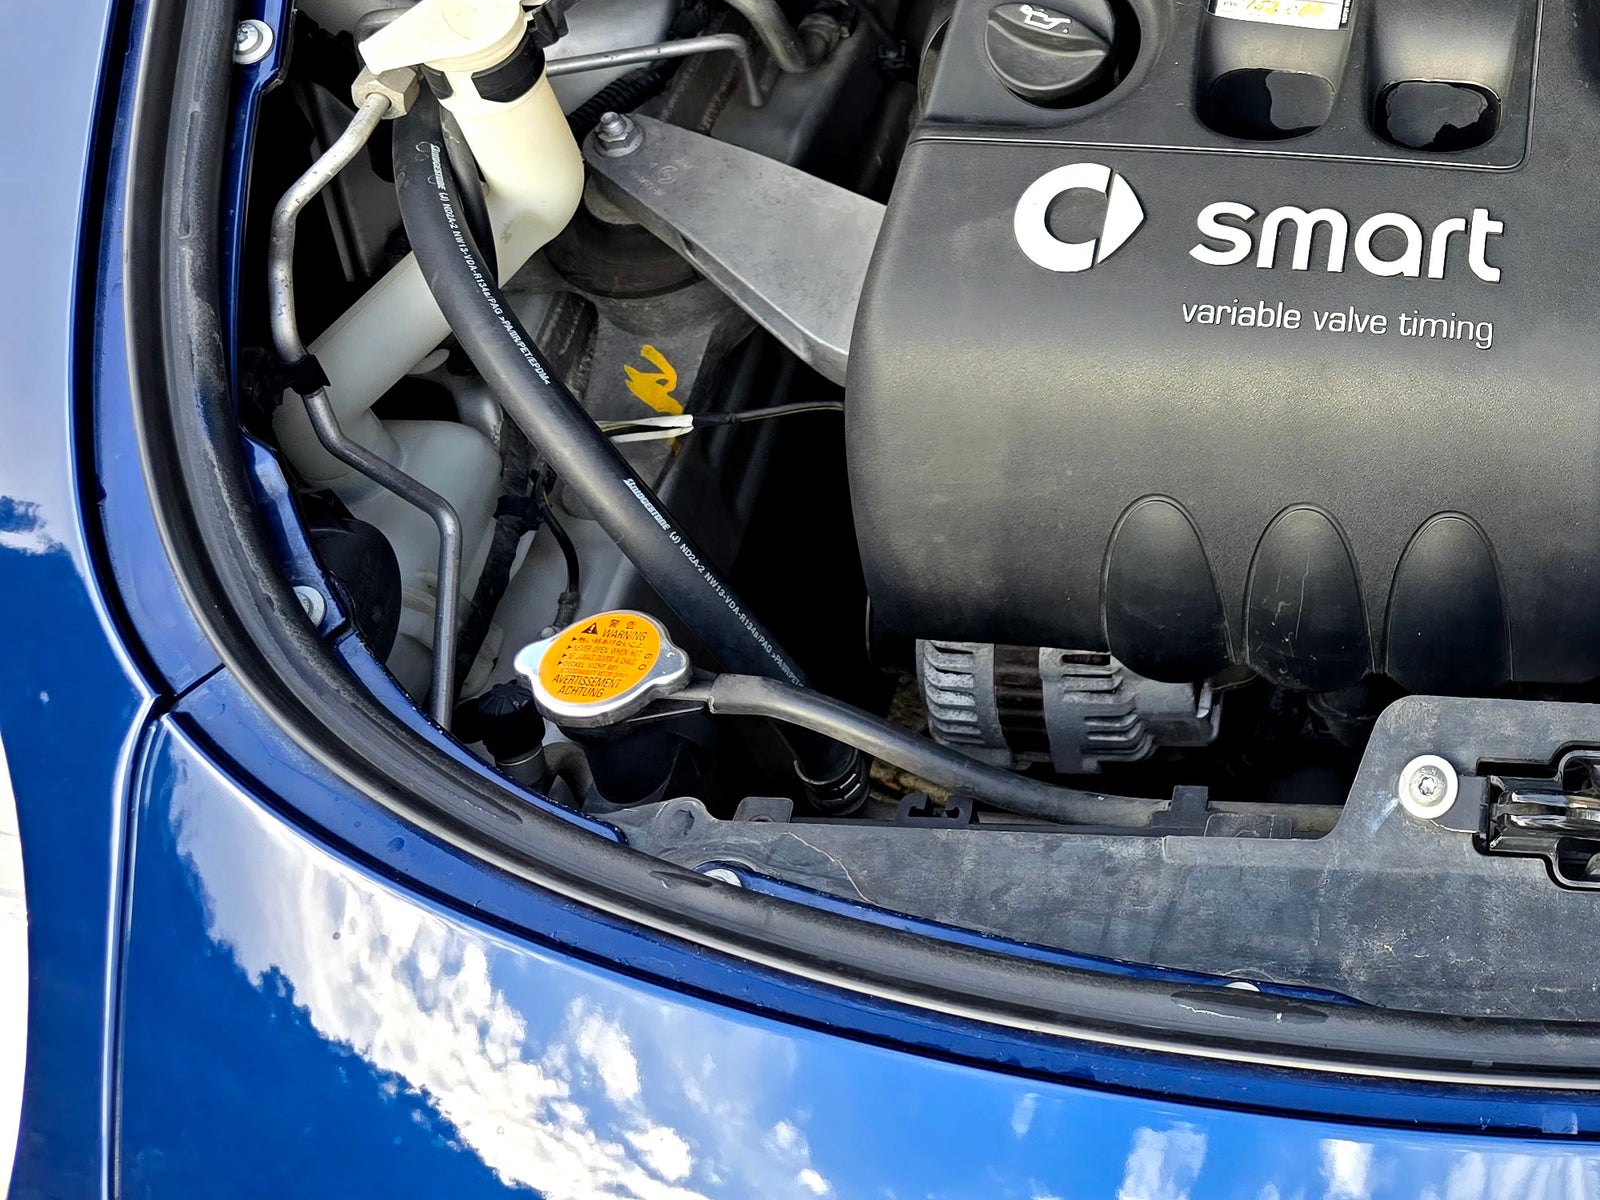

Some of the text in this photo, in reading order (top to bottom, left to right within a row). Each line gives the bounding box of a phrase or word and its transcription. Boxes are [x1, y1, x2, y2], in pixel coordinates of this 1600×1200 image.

[1189, 201, 1504, 283] smart
[1181, 298, 1494, 350] variable valve timing
[680, 543, 706, 574] ND2A-2
[602, 629, 647, 641] WARNING
[553, 674, 623, 688] AVERTISSEMENT
[558, 685, 605, 698] ACHTUNG
